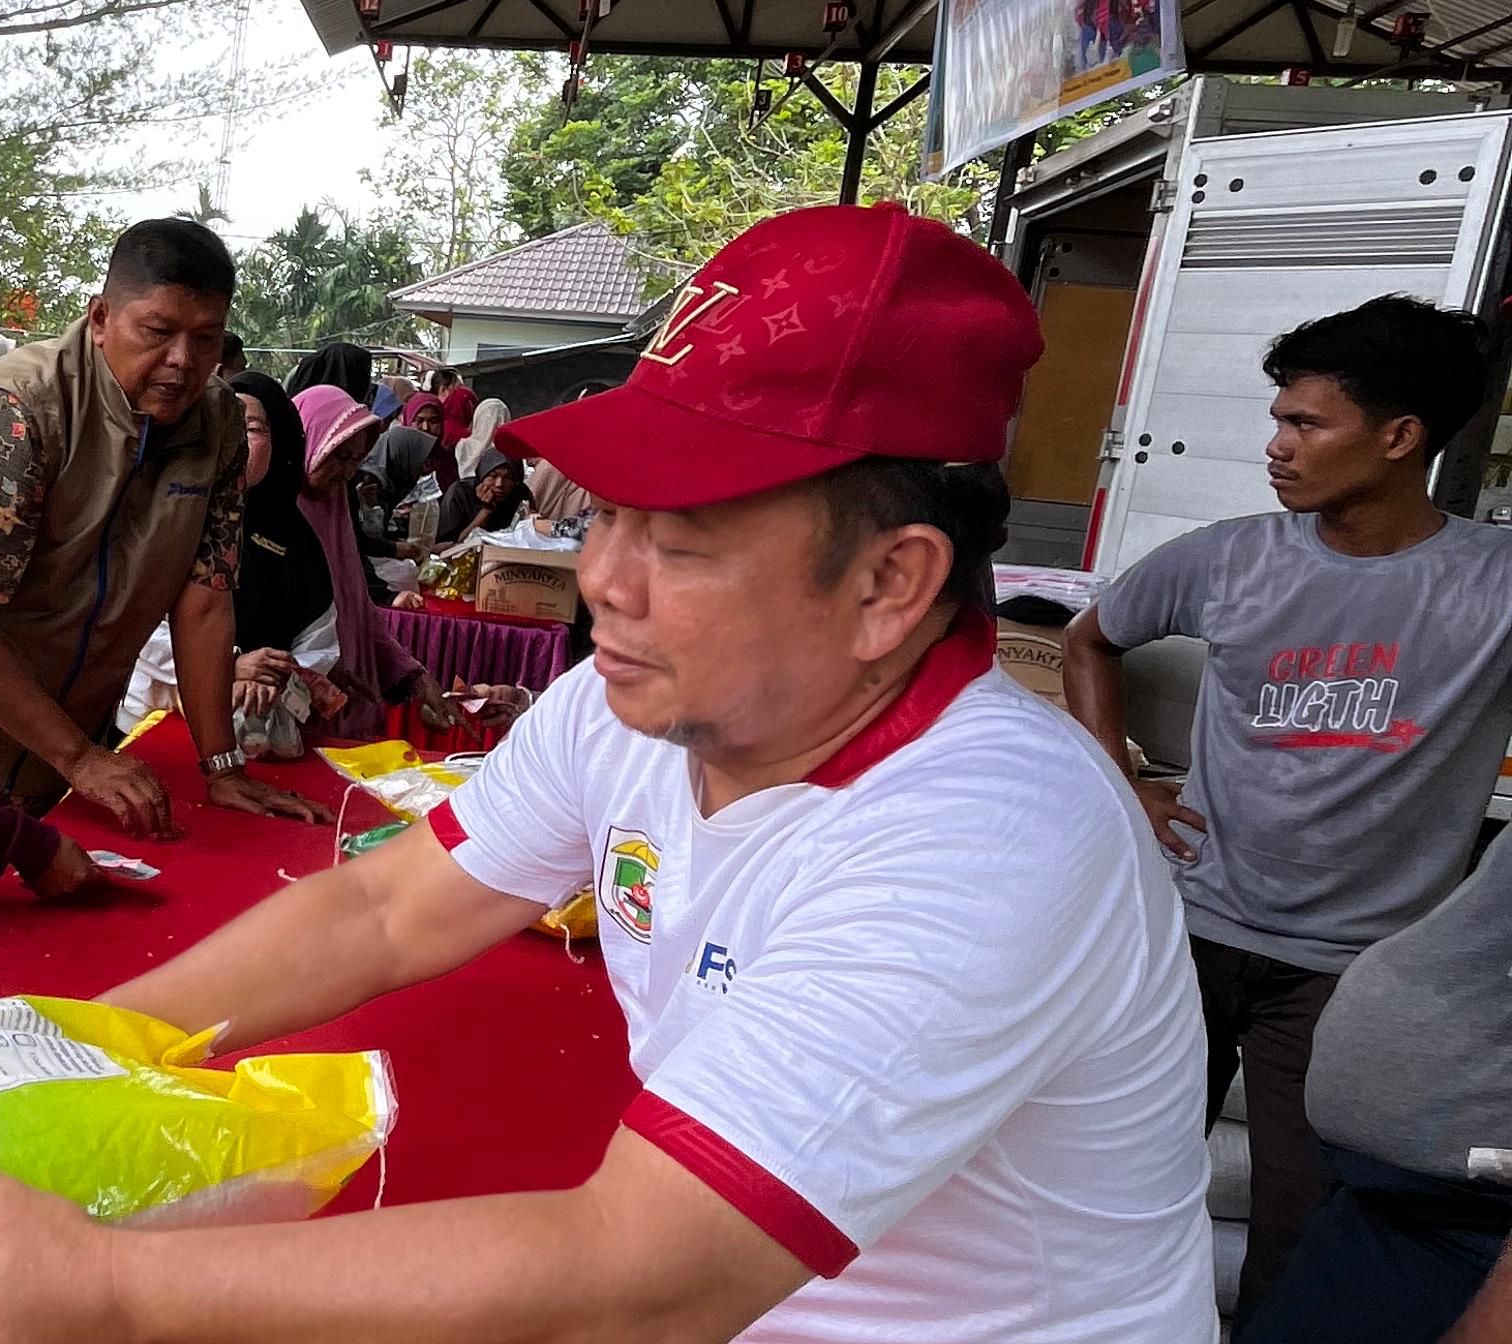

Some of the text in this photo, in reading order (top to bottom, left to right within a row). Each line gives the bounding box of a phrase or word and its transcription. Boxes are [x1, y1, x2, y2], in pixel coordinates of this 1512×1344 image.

[829, 7, 849, 22] 10
[791, 56, 803, 69] 3
[997, 646, 1063, 670] NYAKIT
[1268, 641, 1401, 683] GREEN
[1251, 678, 1399, 734] LIGTH
